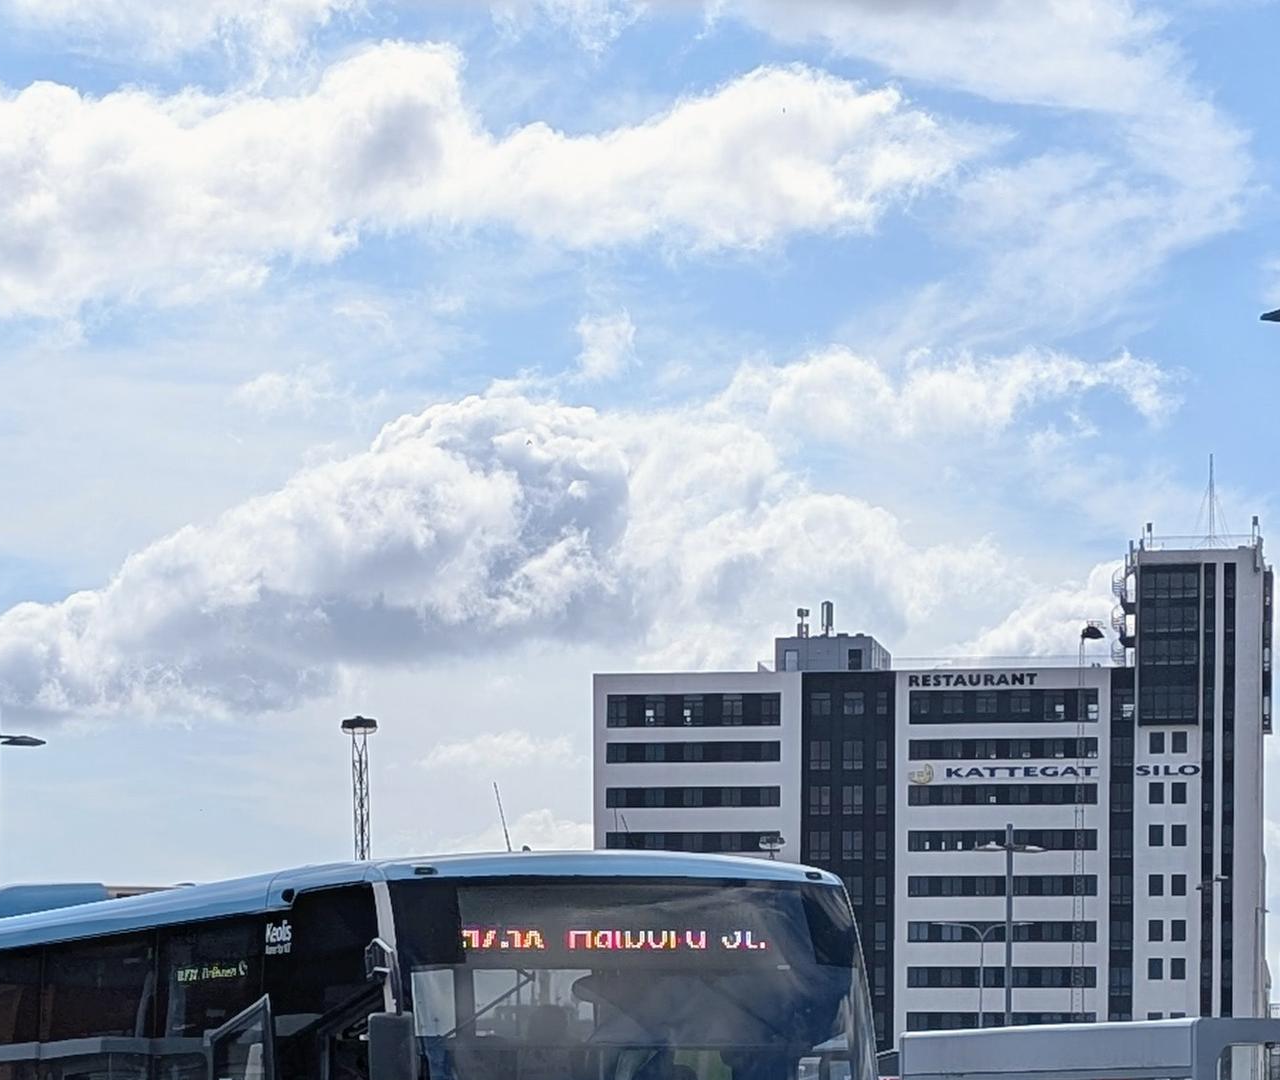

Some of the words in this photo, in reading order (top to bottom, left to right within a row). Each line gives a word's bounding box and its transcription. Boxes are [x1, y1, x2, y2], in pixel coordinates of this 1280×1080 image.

[908, 673, 1038, 687] RESTAURANT
[945, 766, 1099, 779] KATTEGAT
[1135, 764, 1201, 777] SILO
[265, 919, 292, 943] Keolis
